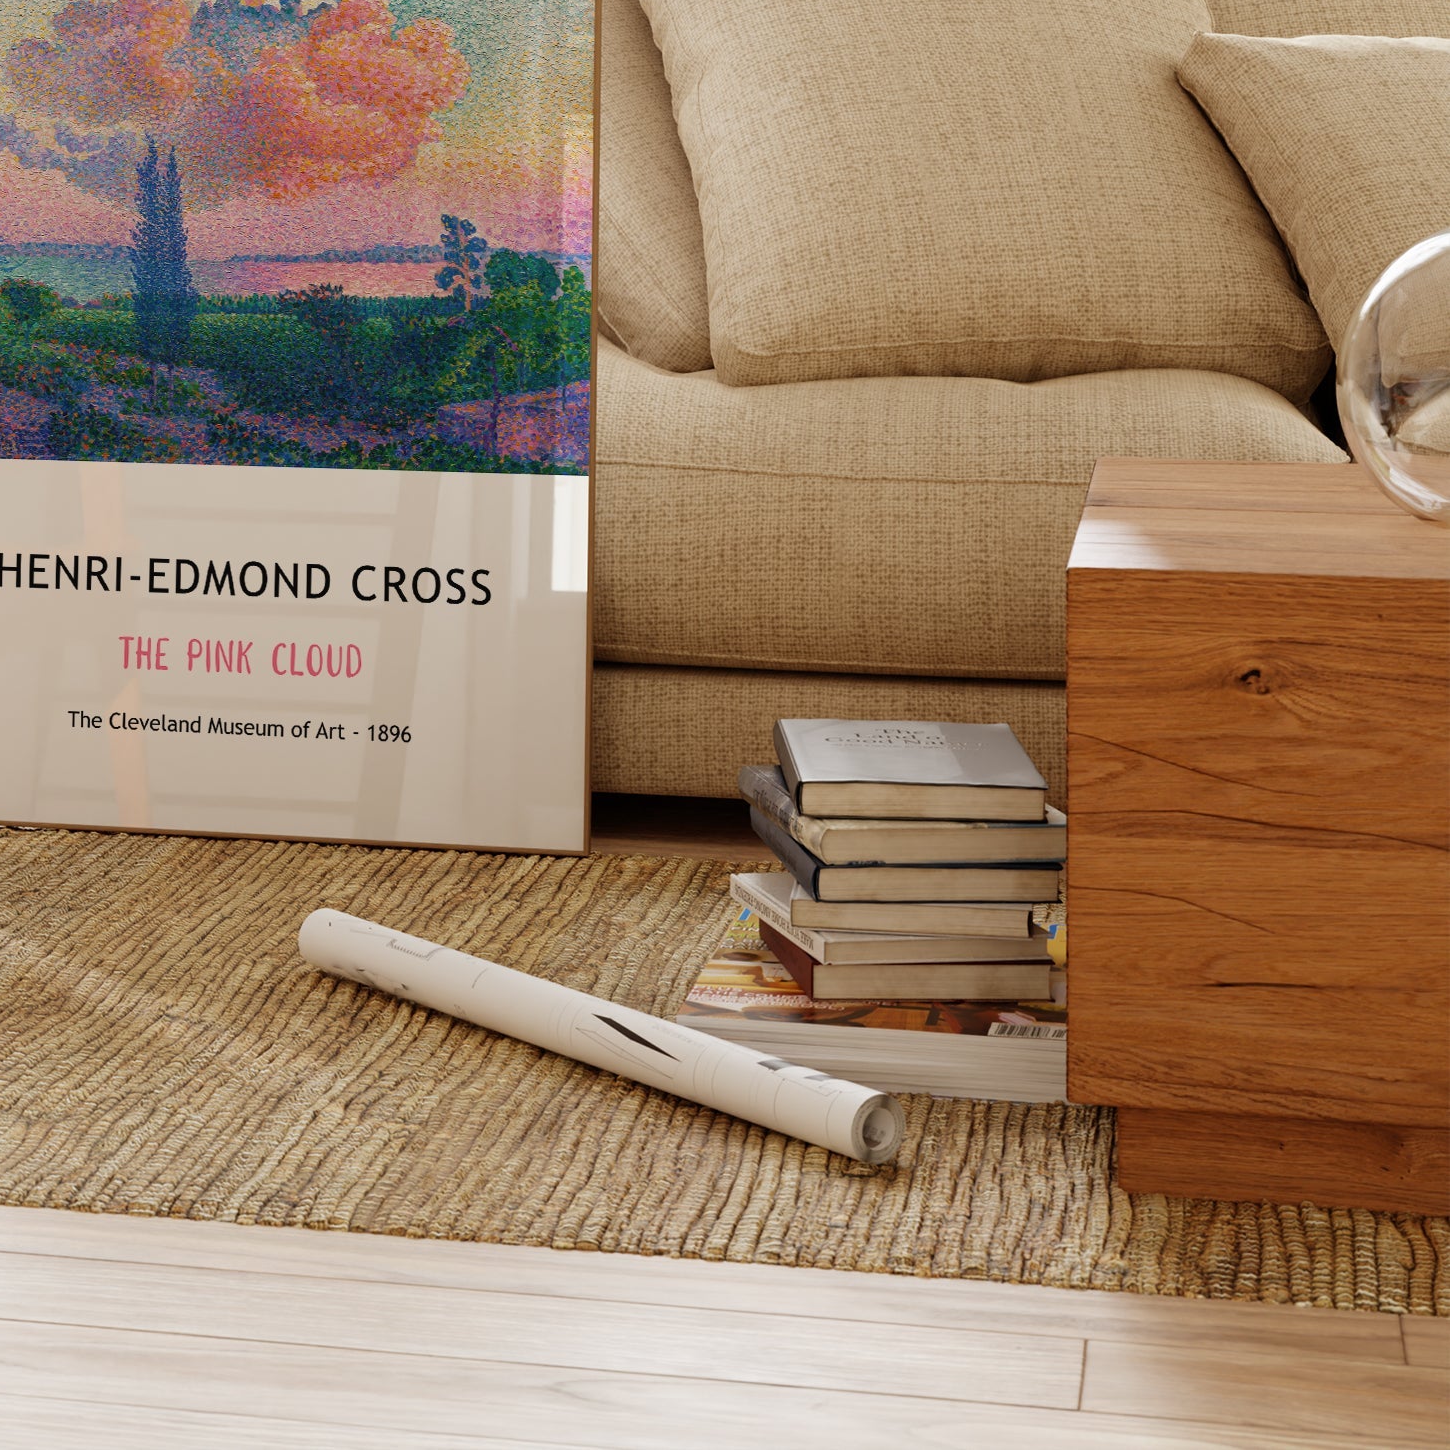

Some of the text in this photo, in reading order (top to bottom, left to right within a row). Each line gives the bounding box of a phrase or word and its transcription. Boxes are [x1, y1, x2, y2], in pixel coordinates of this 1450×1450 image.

[351, 564, 492, 606] CROSS
[118, 635, 363, 679] THE PINK CLOUD
[67, 710, 103, 729] The
[108, 711, 202, 734] Cleveland
[207, 717, 285, 738] Museum
[290, 720, 312, 739] of
[315, 721, 346, 741] Art
[367, 724, 412, 744] 1896
